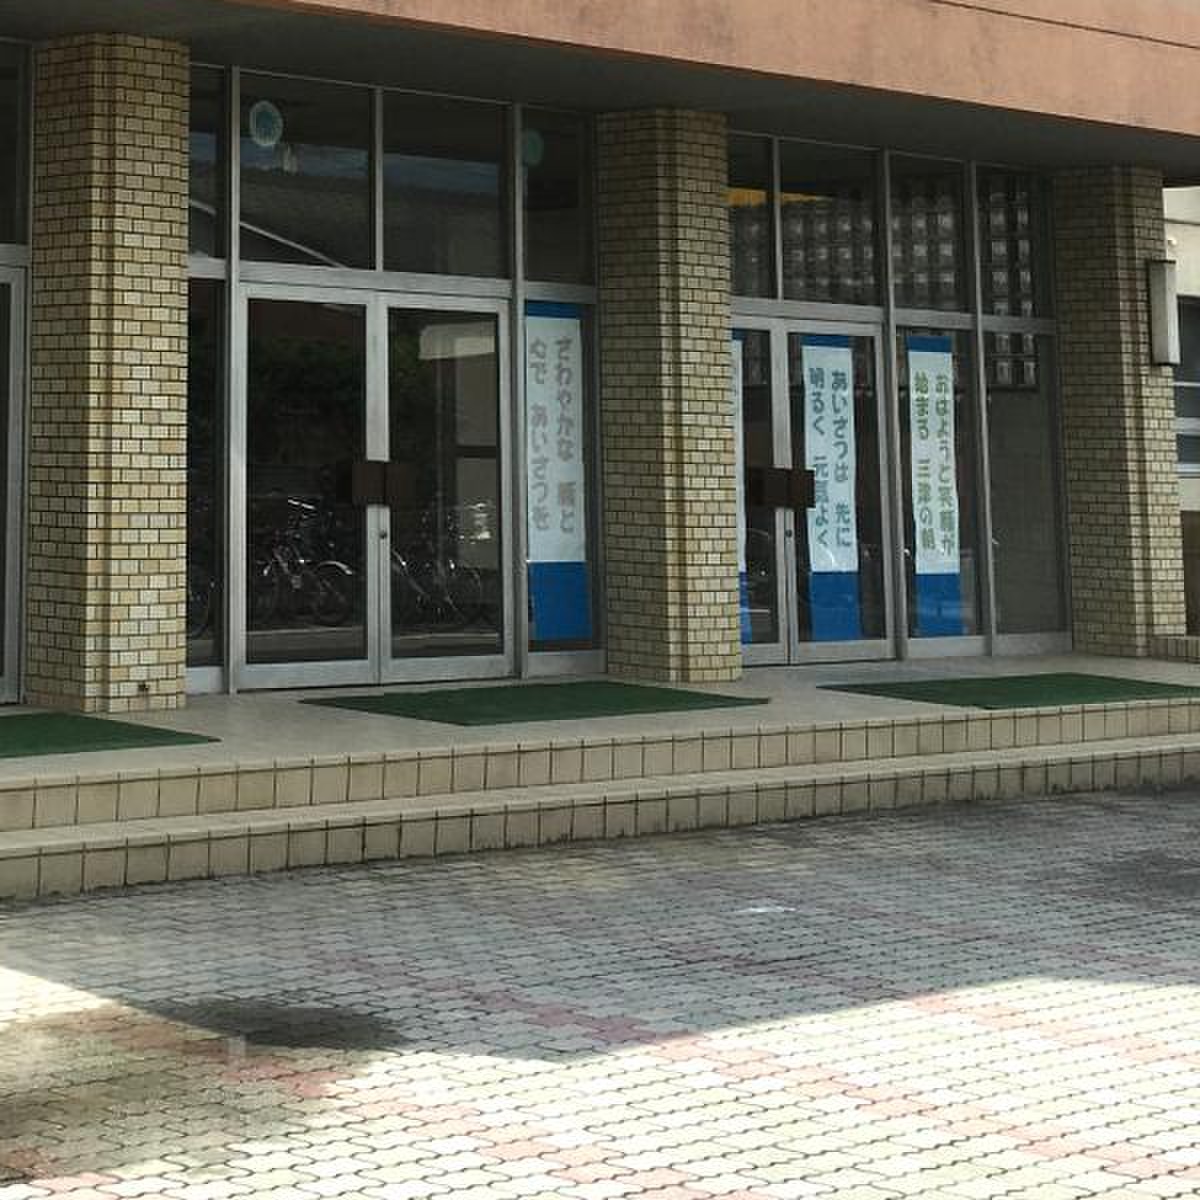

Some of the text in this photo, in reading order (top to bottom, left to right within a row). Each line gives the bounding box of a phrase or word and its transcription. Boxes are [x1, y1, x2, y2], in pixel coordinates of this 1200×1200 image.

[831, 369, 848, 483] あいさつは
